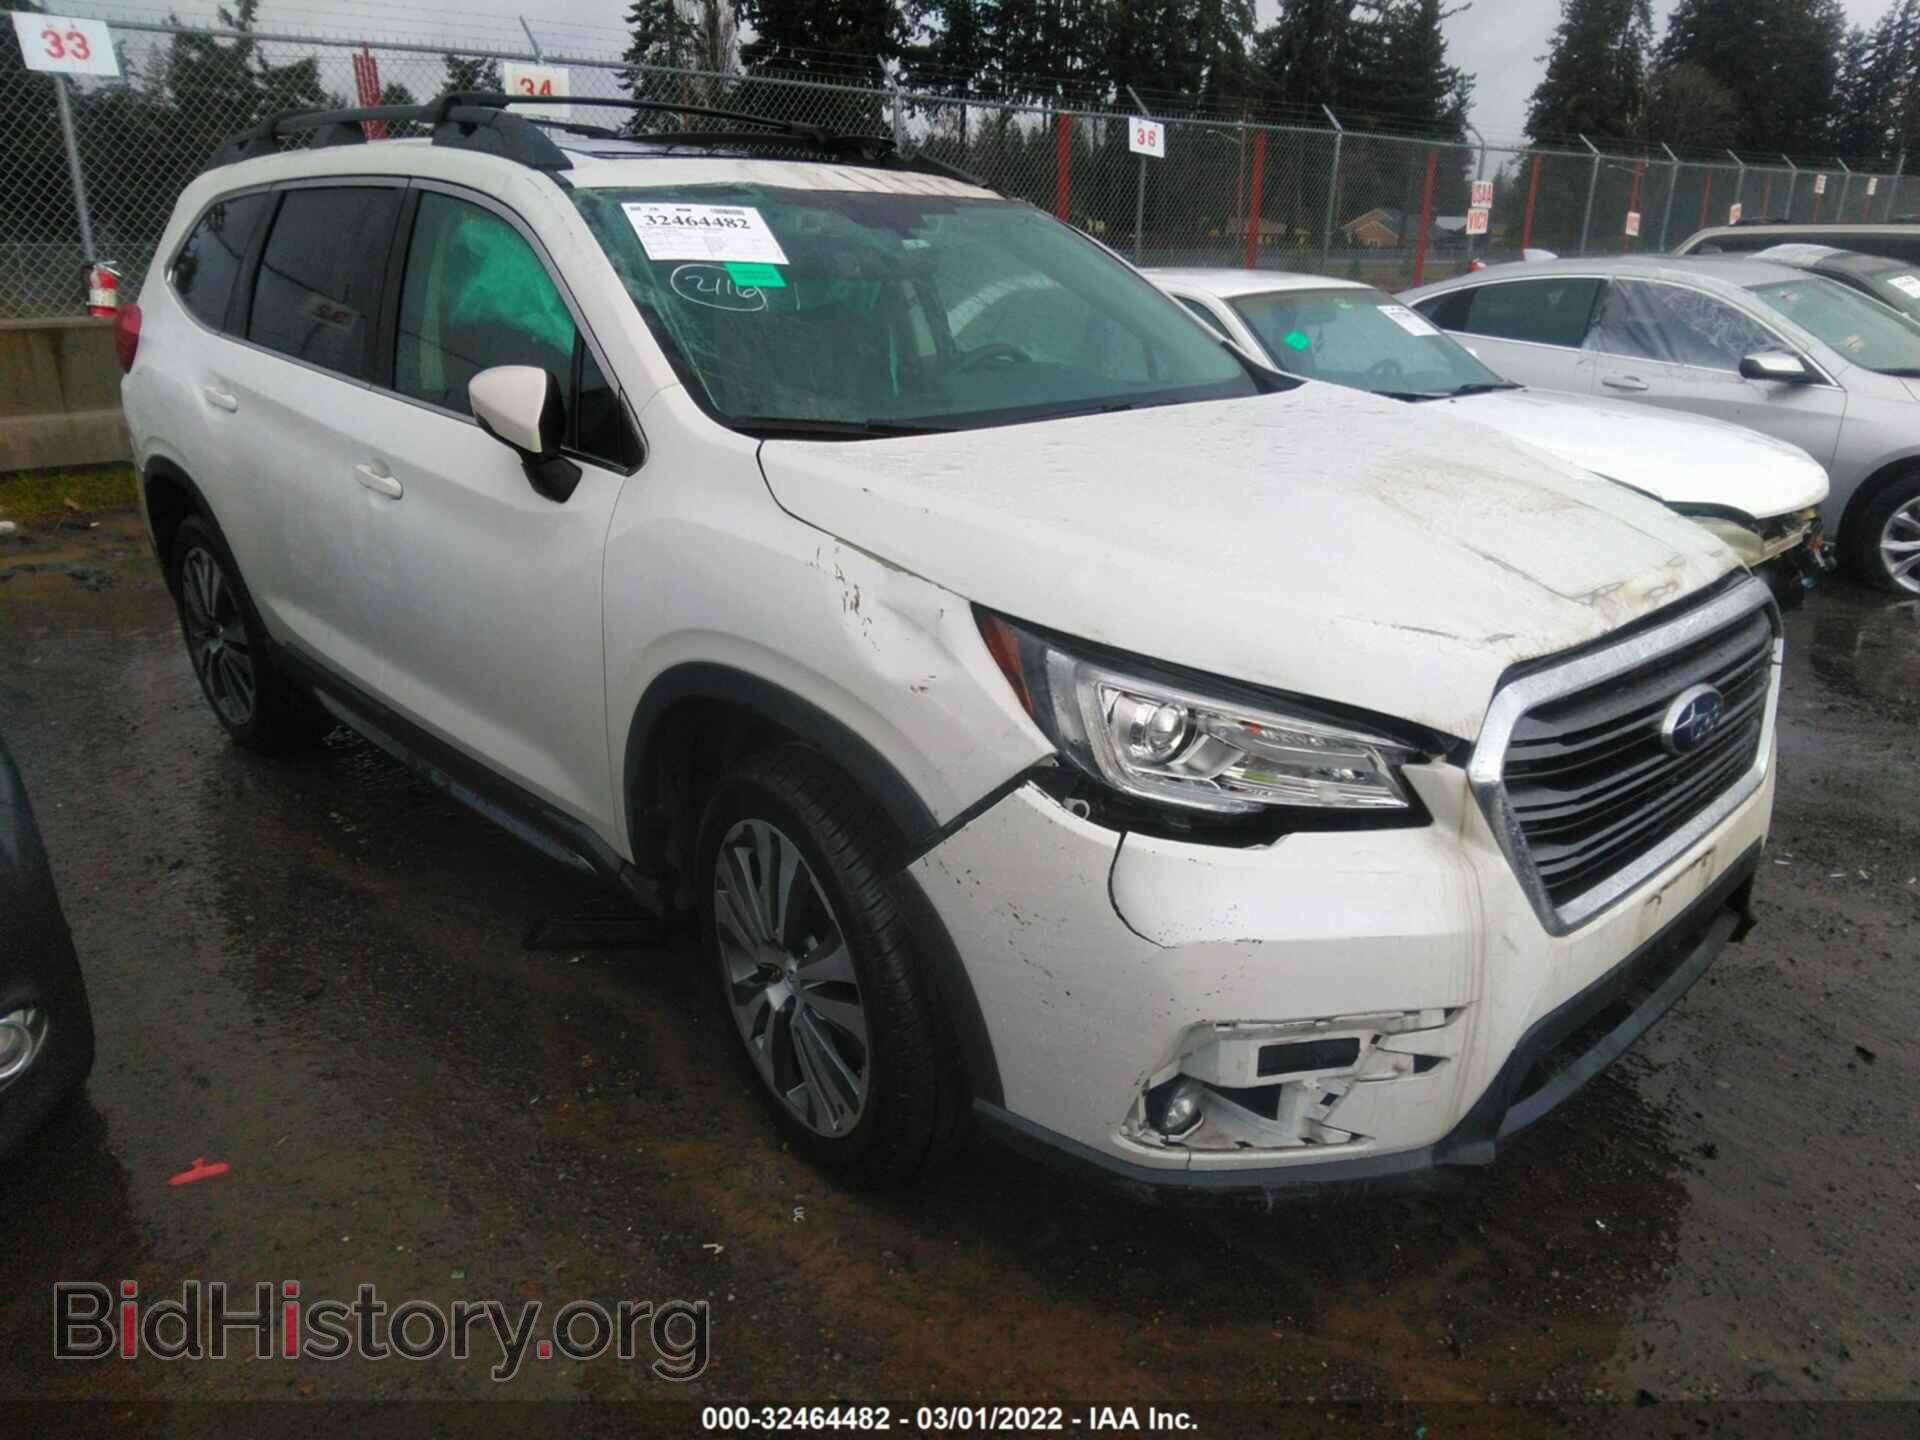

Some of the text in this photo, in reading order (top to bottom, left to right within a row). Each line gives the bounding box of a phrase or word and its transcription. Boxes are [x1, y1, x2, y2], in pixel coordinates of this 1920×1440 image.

[41, 29, 90, 60] 33
[519, 77, 553, 97] 34
[1136, 127, 1156, 147] 36
[643, 214, 751, 230] 32464482
